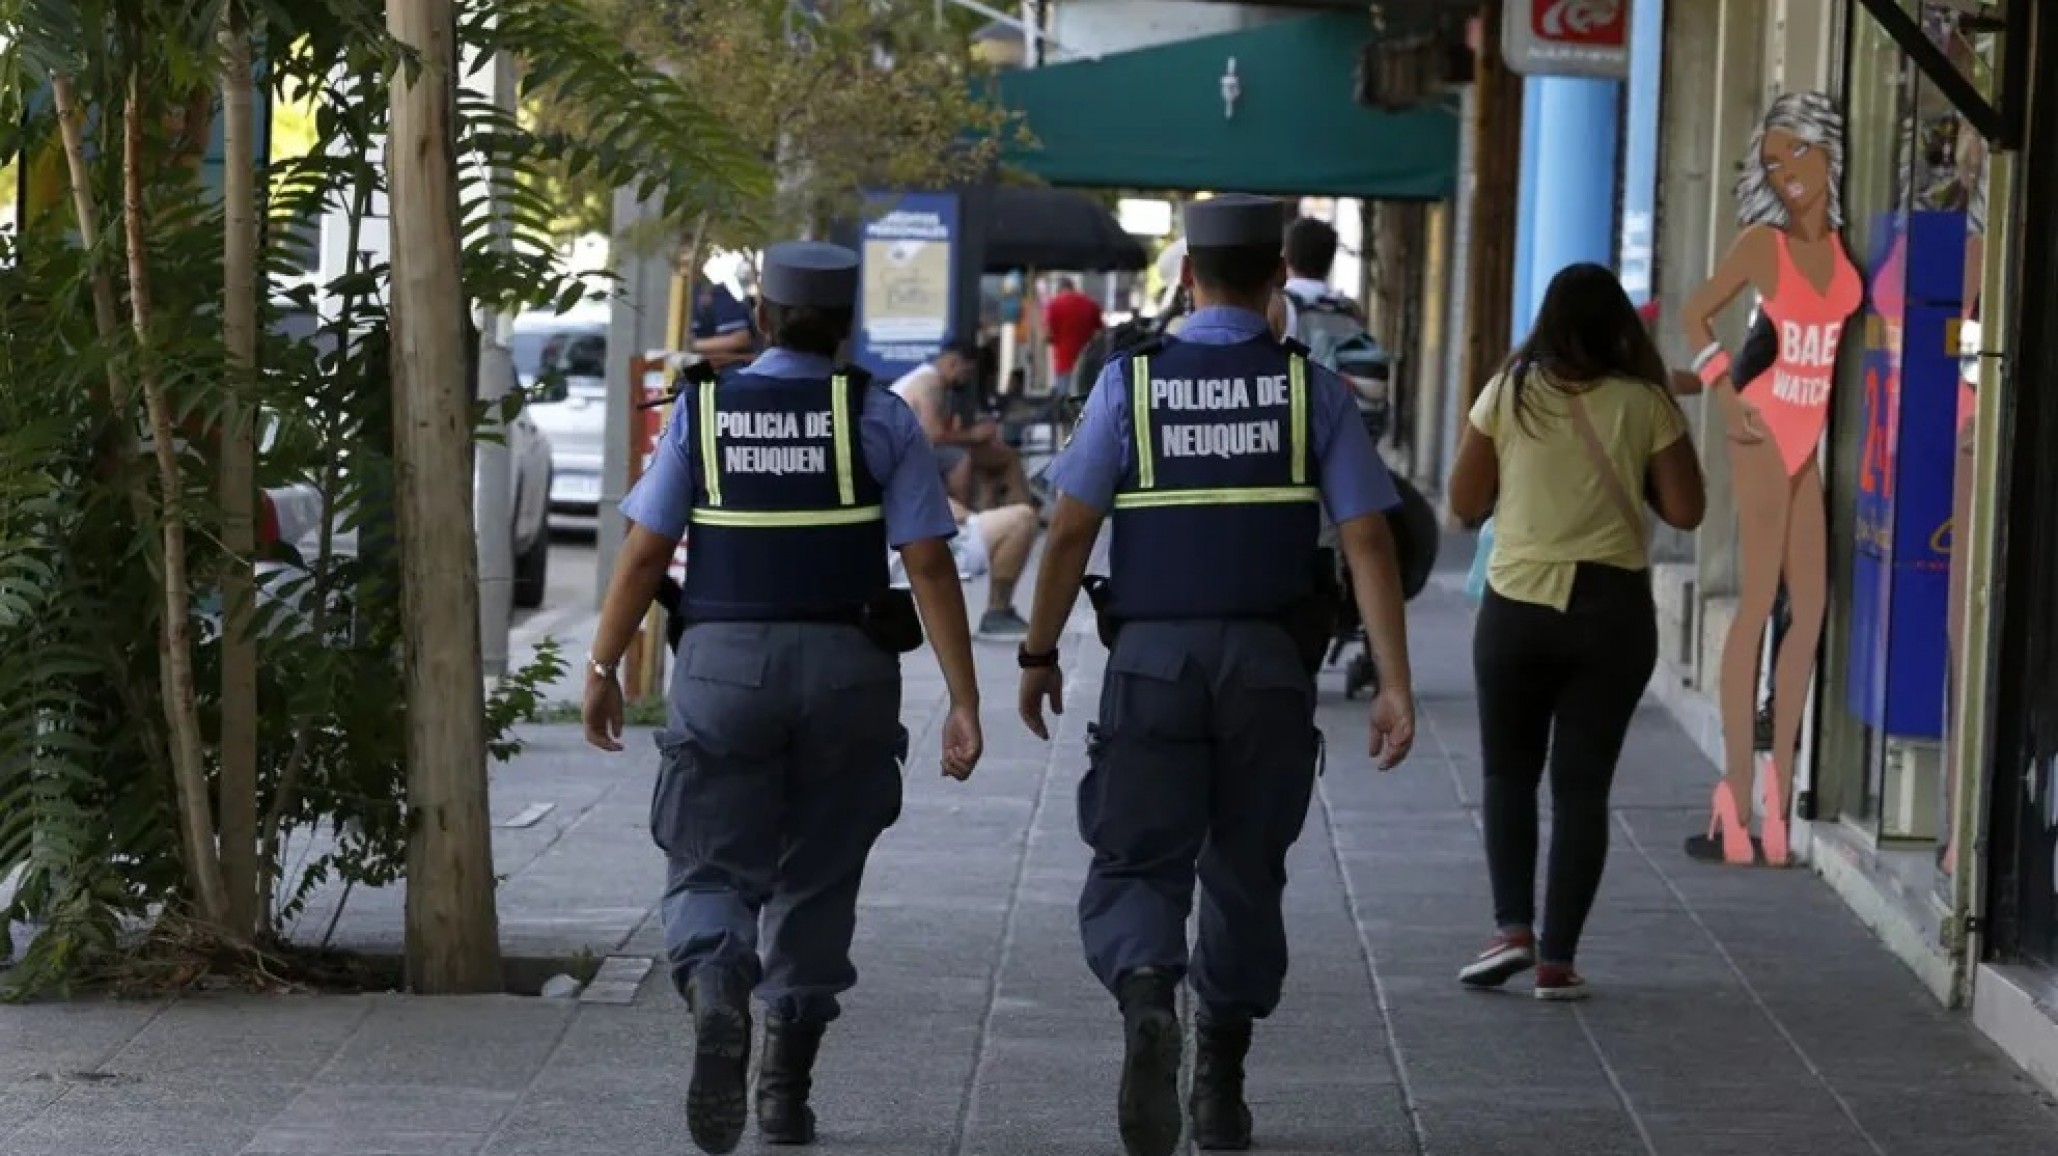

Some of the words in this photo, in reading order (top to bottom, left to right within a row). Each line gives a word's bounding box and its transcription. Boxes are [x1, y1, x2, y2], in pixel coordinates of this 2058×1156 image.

[1782, 320, 1841, 367] BAE
[1150, 377, 1250, 411] POLICIA
[1256, 374, 1289, 408] DE
[716, 410, 800, 439] POLICIA
[804, 410, 833, 439] DE
[1162, 419, 1279, 459] NEUQUEN
[725, 445, 826, 476] NEUQUEN
